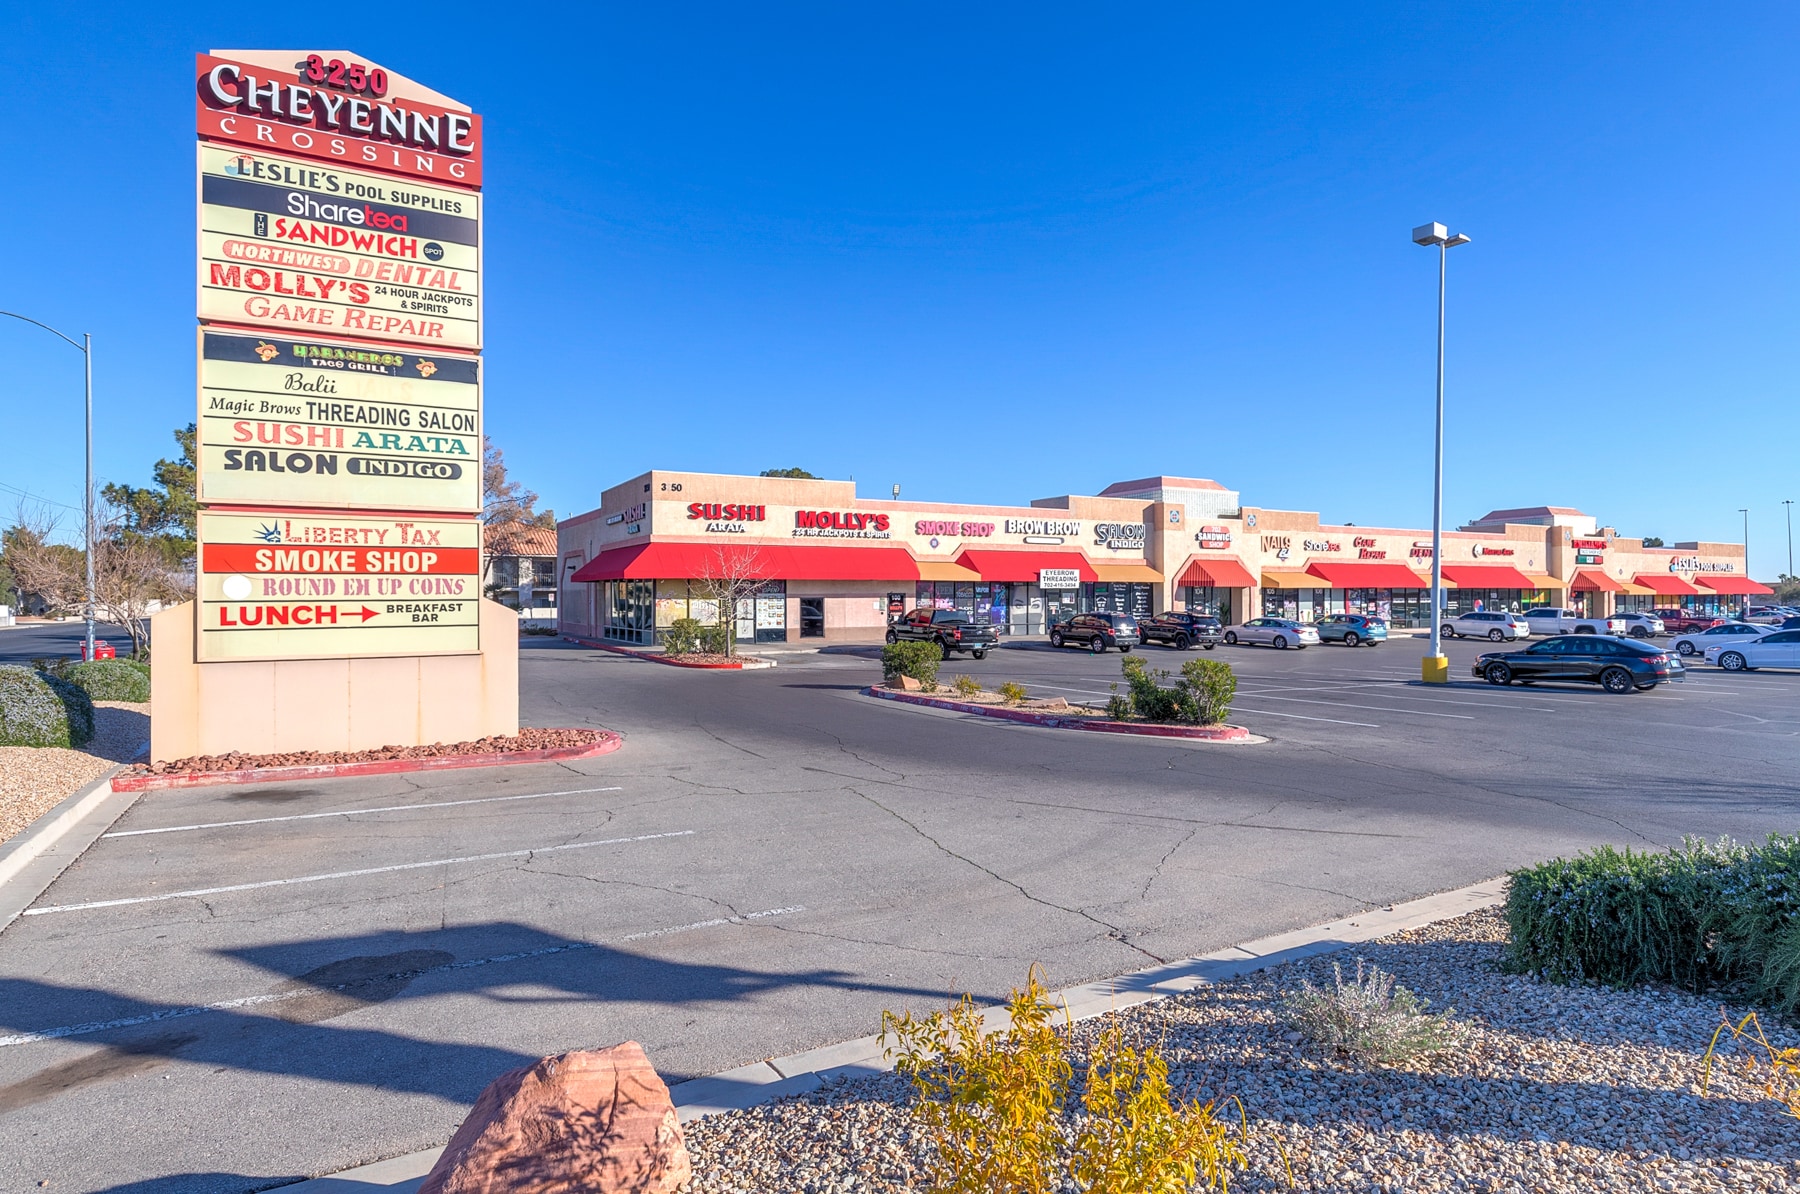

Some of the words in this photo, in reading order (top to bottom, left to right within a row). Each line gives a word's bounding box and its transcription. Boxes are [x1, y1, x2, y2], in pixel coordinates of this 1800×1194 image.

[306, 54, 388, 95] 3250
[209, 64, 475, 153] CHEYENNE
[220, 117, 466, 178] CROSSING
[237, 158, 339, 192] LESLIE'S
[345, 183, 386, 201] POOL
[391, 191, 462, 213] SUPPLIES
[287, 192, 408, 232] Sharetea
[257, 214, 265, 236] THE
[275, 218, 417, 258] SANDWICH
[230, 243, 342, 271] NORTHWEST
[424, 247, 443, 256] SPOT
[210, 263, 370, 305] MOLLY'S
[354, 259, 462, 291] DENTAL
[374, 286, 387, 296] 24
[390, 287, 419, 300] HOUR
[421, 291, 473, 307] JACKPOTS
[400, 300, 408, 309] &
[411, 301, 448, 314] SPIRITS
[244, 297, 334, 325] GAME
[342, 308, 444, 338] REPAIR
[293, 345, 404, 367] HABANEROS
[311, 359, 344, 368] TACO
[348, 362, 388, 374] GRILL
[284, 372, 337, 394] Balii
[209, 397, 255, 413] Magic
[260, 400, 301, 416] Brows
[306, 401, 410, 426] THREADING
[418, 411, 474, 432] SALON
[233, 421, 344, 448] SUSHI
[352, 431, 470, 455] ARATA
[224, 450, 338, 475] SALON
[357, 459, 452, 478] INDIGO
[688, 503, 766, 521] SUSHI
[796, 511, 890, 531] MOLLY'S
[284, 520, 389, 545] LIBERTY
[395, 522, 441, 545] TAX
[708, 523, 746, 532] ARATA
[795, 529, 805, 537] 24
[819, 529, 857, 538] JACKPOTS
[867, 531, 892, 539] SPIRITS
[917, 520, 960, 536] SMOKE
[964, 522, 995, 537] SHOP
[1008, 520, 1045, 535] BROW
[1048, 521, 1081, 536] BROW
[1096, 523, 1146, 544] SALON
[1198, 532, 1233, 542] SANDWICH
[1110, 540, 1145, 549] INDIGO
[1261, 535, 1291, 552] NAILS
[255, 549, 355, 572] SMOKE
[366, 550, 438, 572] SHOP
[263, 578, 336, 596] ROUND
[377, 578, 402, 596] UP
[409, 578, 465, 596] COINS
[220, 605, 337, 626] LUNCH
[386, 603, 463, 613] BREAKFAST
[412, 613, 438, 623] BAR
